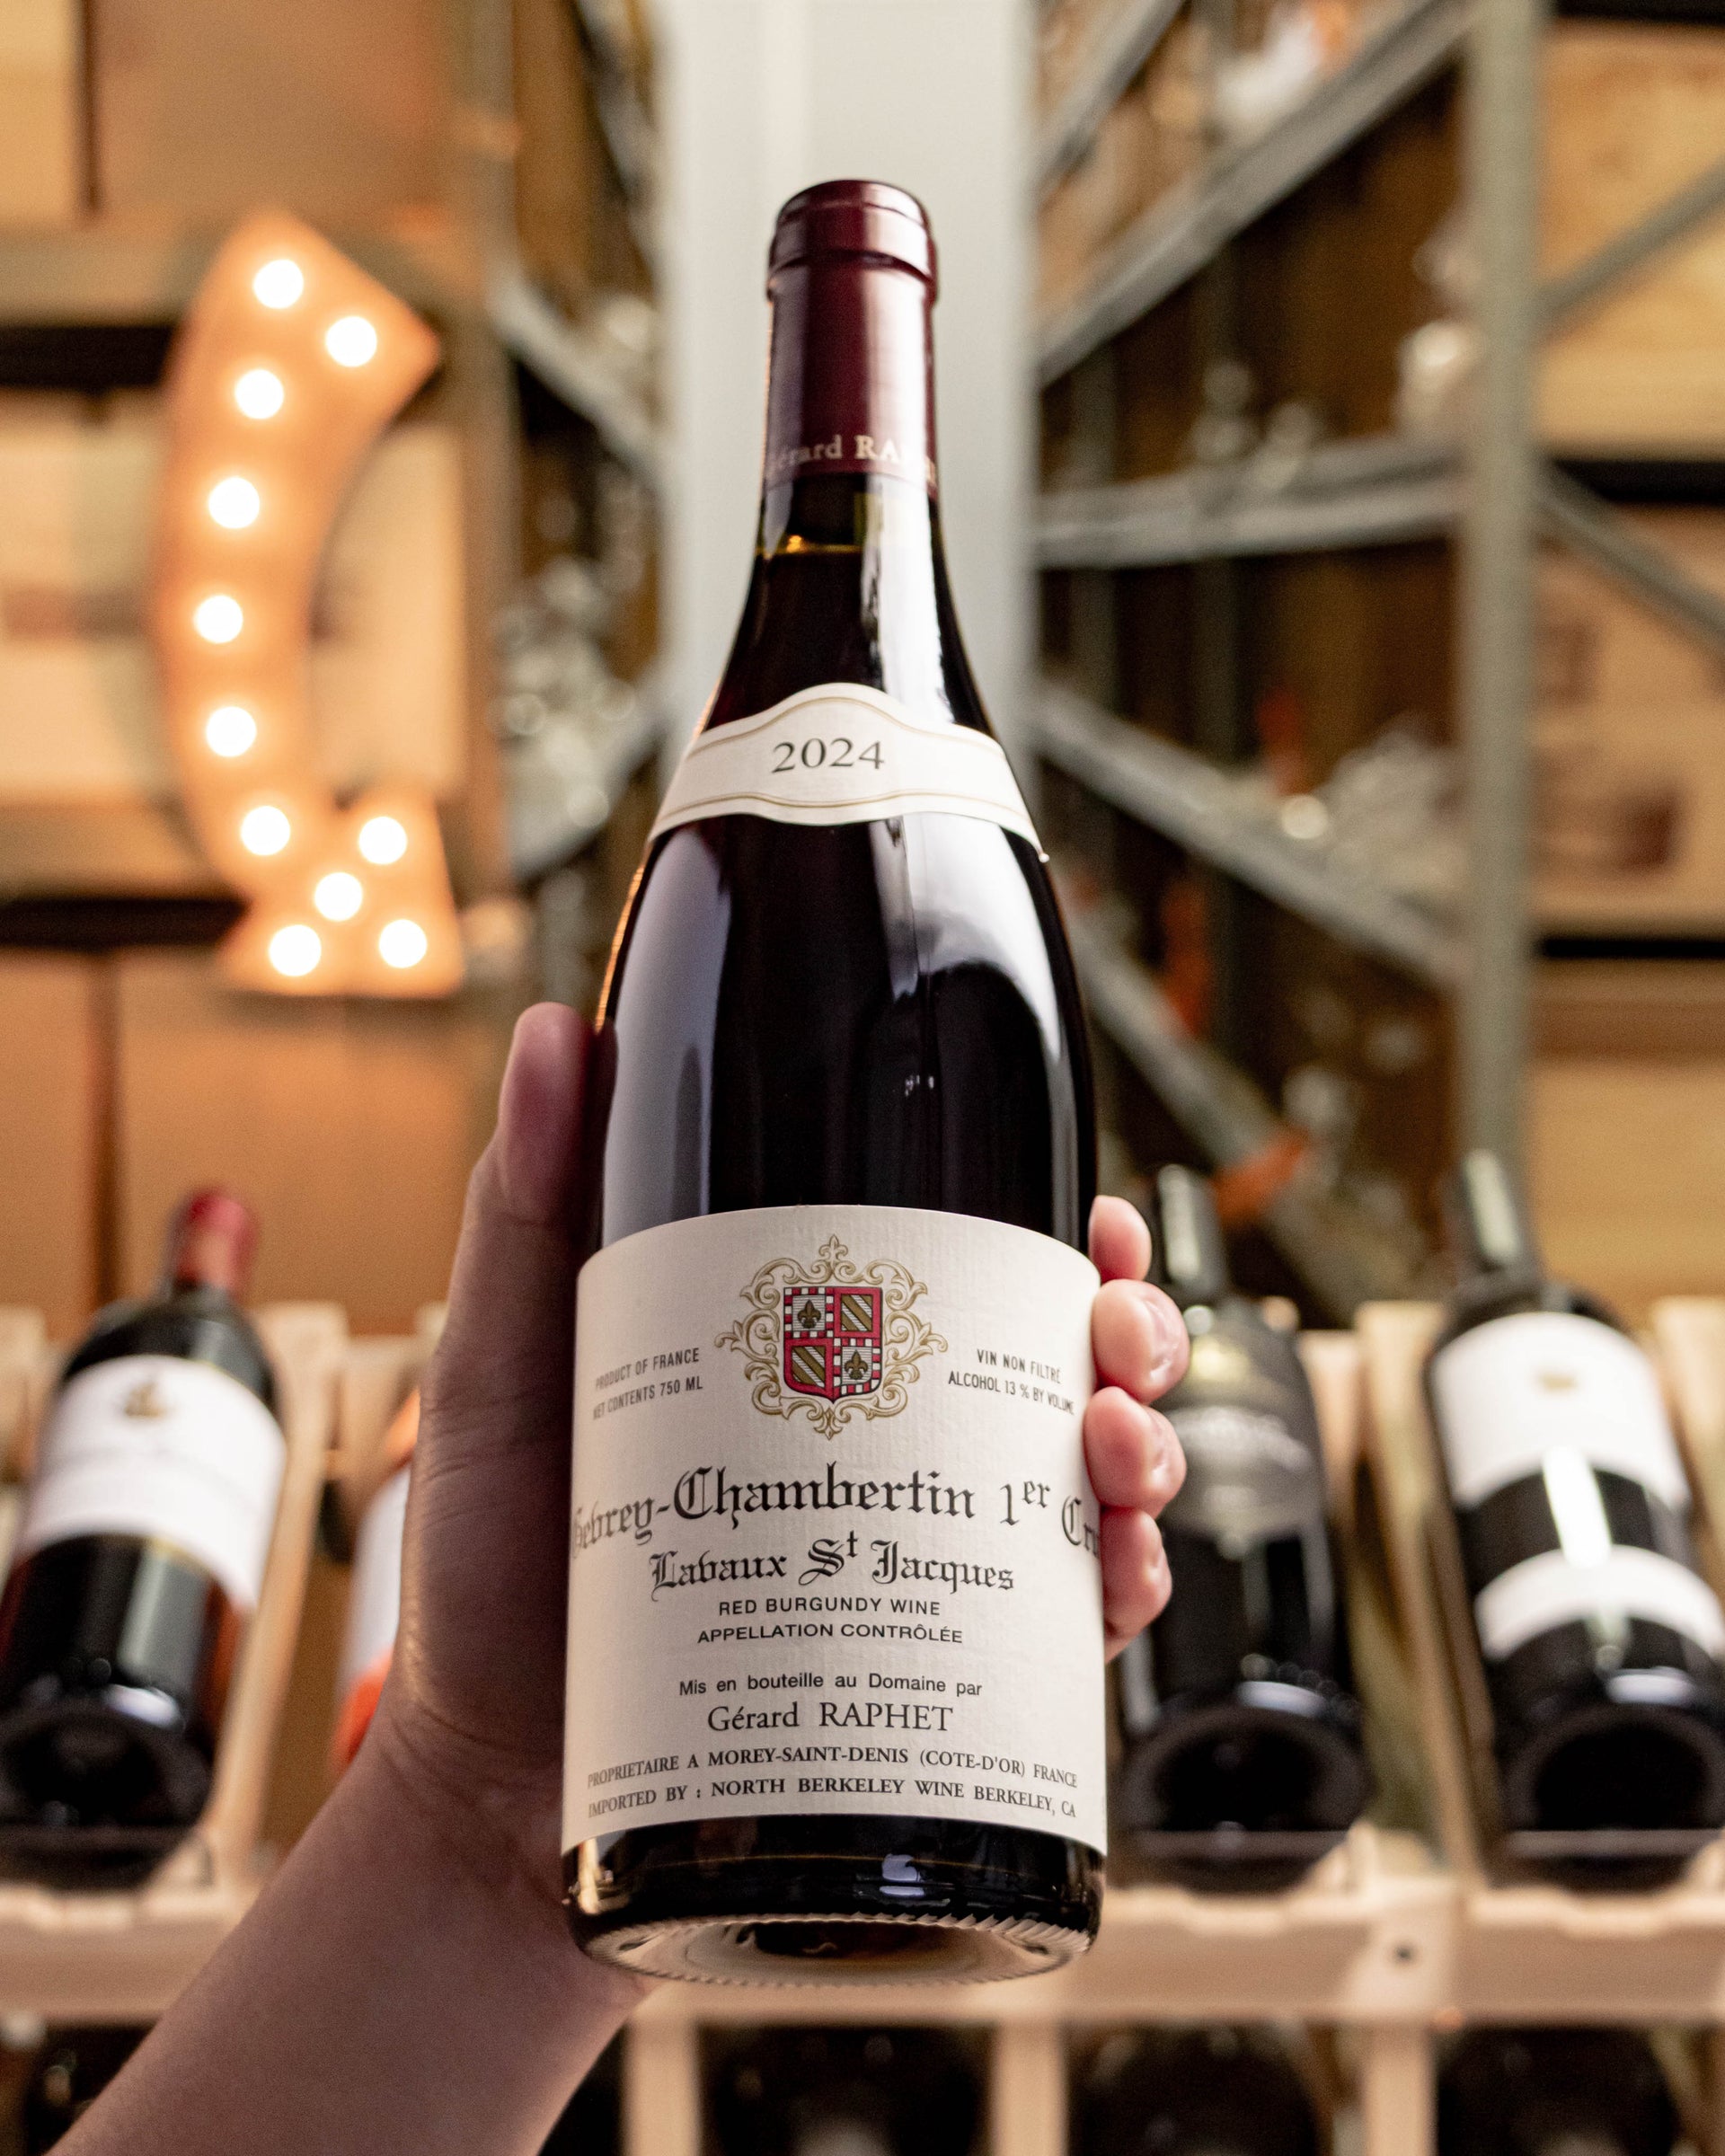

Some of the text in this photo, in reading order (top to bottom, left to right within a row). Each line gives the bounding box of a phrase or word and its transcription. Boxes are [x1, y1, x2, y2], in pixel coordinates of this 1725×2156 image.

[772, 738, 885, 773] 2024
[595, 1348, 700, 1391] PRODUCT OF FRANCE
[977, 1348, 997, 1365] VIN
[1003, 1354, 1025, 1373] NON
[607, 1384, 655, 1413] CONTENTS
[660, 1379, 681, 1397] 750
[686, 1375, 703, 1392] ML
[948, 1370, 1075, 1415] ALCOHOL 13 % BY VOLUME
[650, 1530, 1014, 1602] Lavaux St Jacques
[720, 1596, 940, 1616] RED BURGUNDY WINE
[697, 1623, 962, 1643] APPELLATION CONTRÔLÉE
[679, 1673, 982, 1697] Mis en bouteille au Domaine par
[708, 1701, 953, 1731] Gérard RAPHET
[588, 1746, 1077, 1789] PROPRIETAIRE A MOREY-SAINT-DENIS (COTE-D'OR) FRANCE
[588, 1789, 657, 1818] IMPORTED
[666, 1785, 687, 1802] BY
[712, 1779, 786, 1797] NORTH
[798, 1778, 905, 1794] BERKELEY
[915, 1780, 964, 1798] WINE
[974, 1785, 1056, 1816] BERKELEY,
[1061, 1800, 1076, 1817] CA
